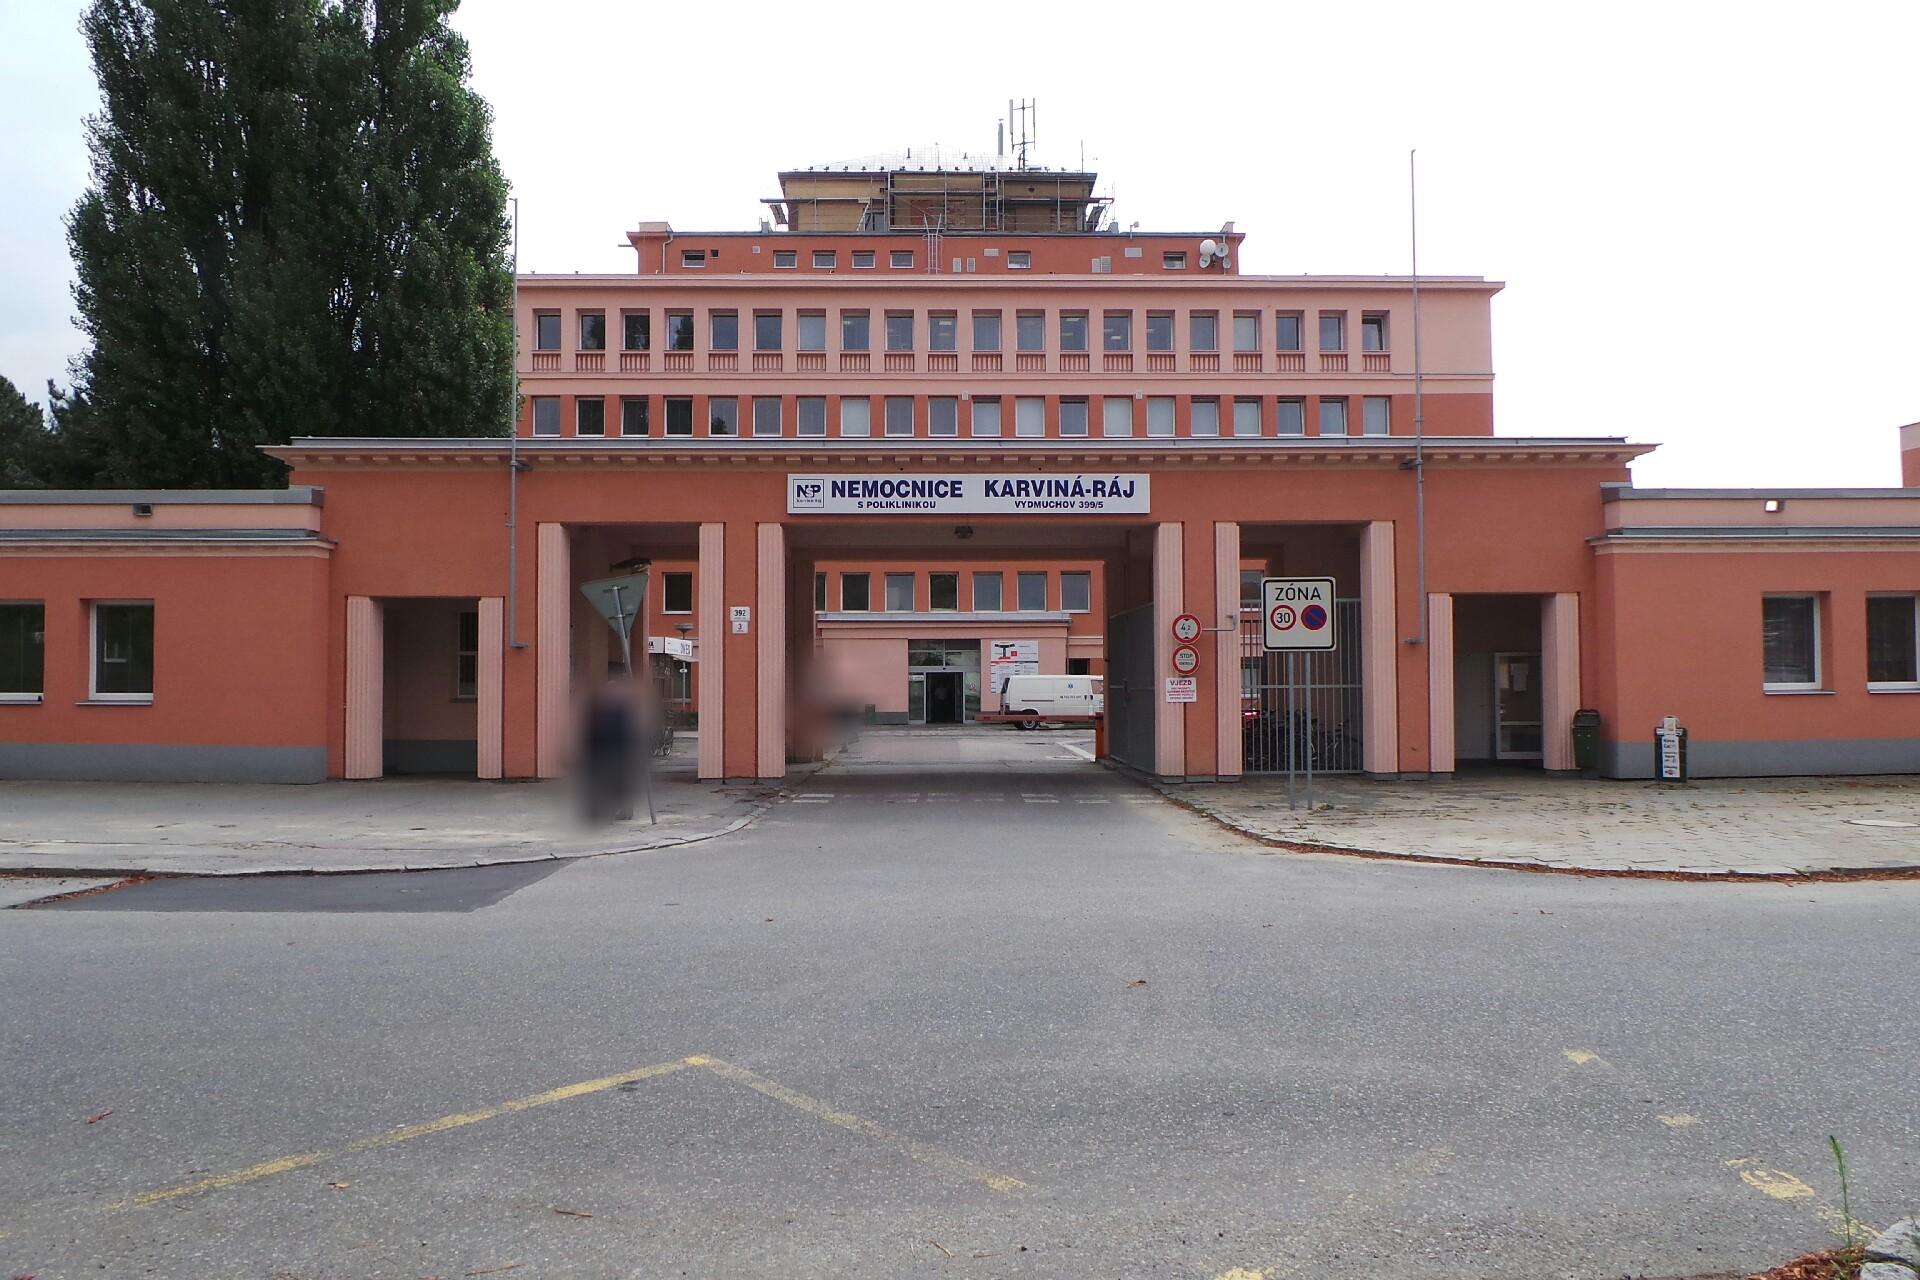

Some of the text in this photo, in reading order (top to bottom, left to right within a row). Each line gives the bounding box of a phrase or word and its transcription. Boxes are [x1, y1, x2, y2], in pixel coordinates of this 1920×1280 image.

[831, 475, 1135, 499] NEMOCNICE KARVINÁ-RÁJ
[857, 500, 1104, 509] S POLIKLINIKOU VYDMUCHOV 399/5
[1274, 582, 1322, 602] ZÓNA
[734, 609, 747, 617] 392
[1276, 612, 1291, 624] 30
